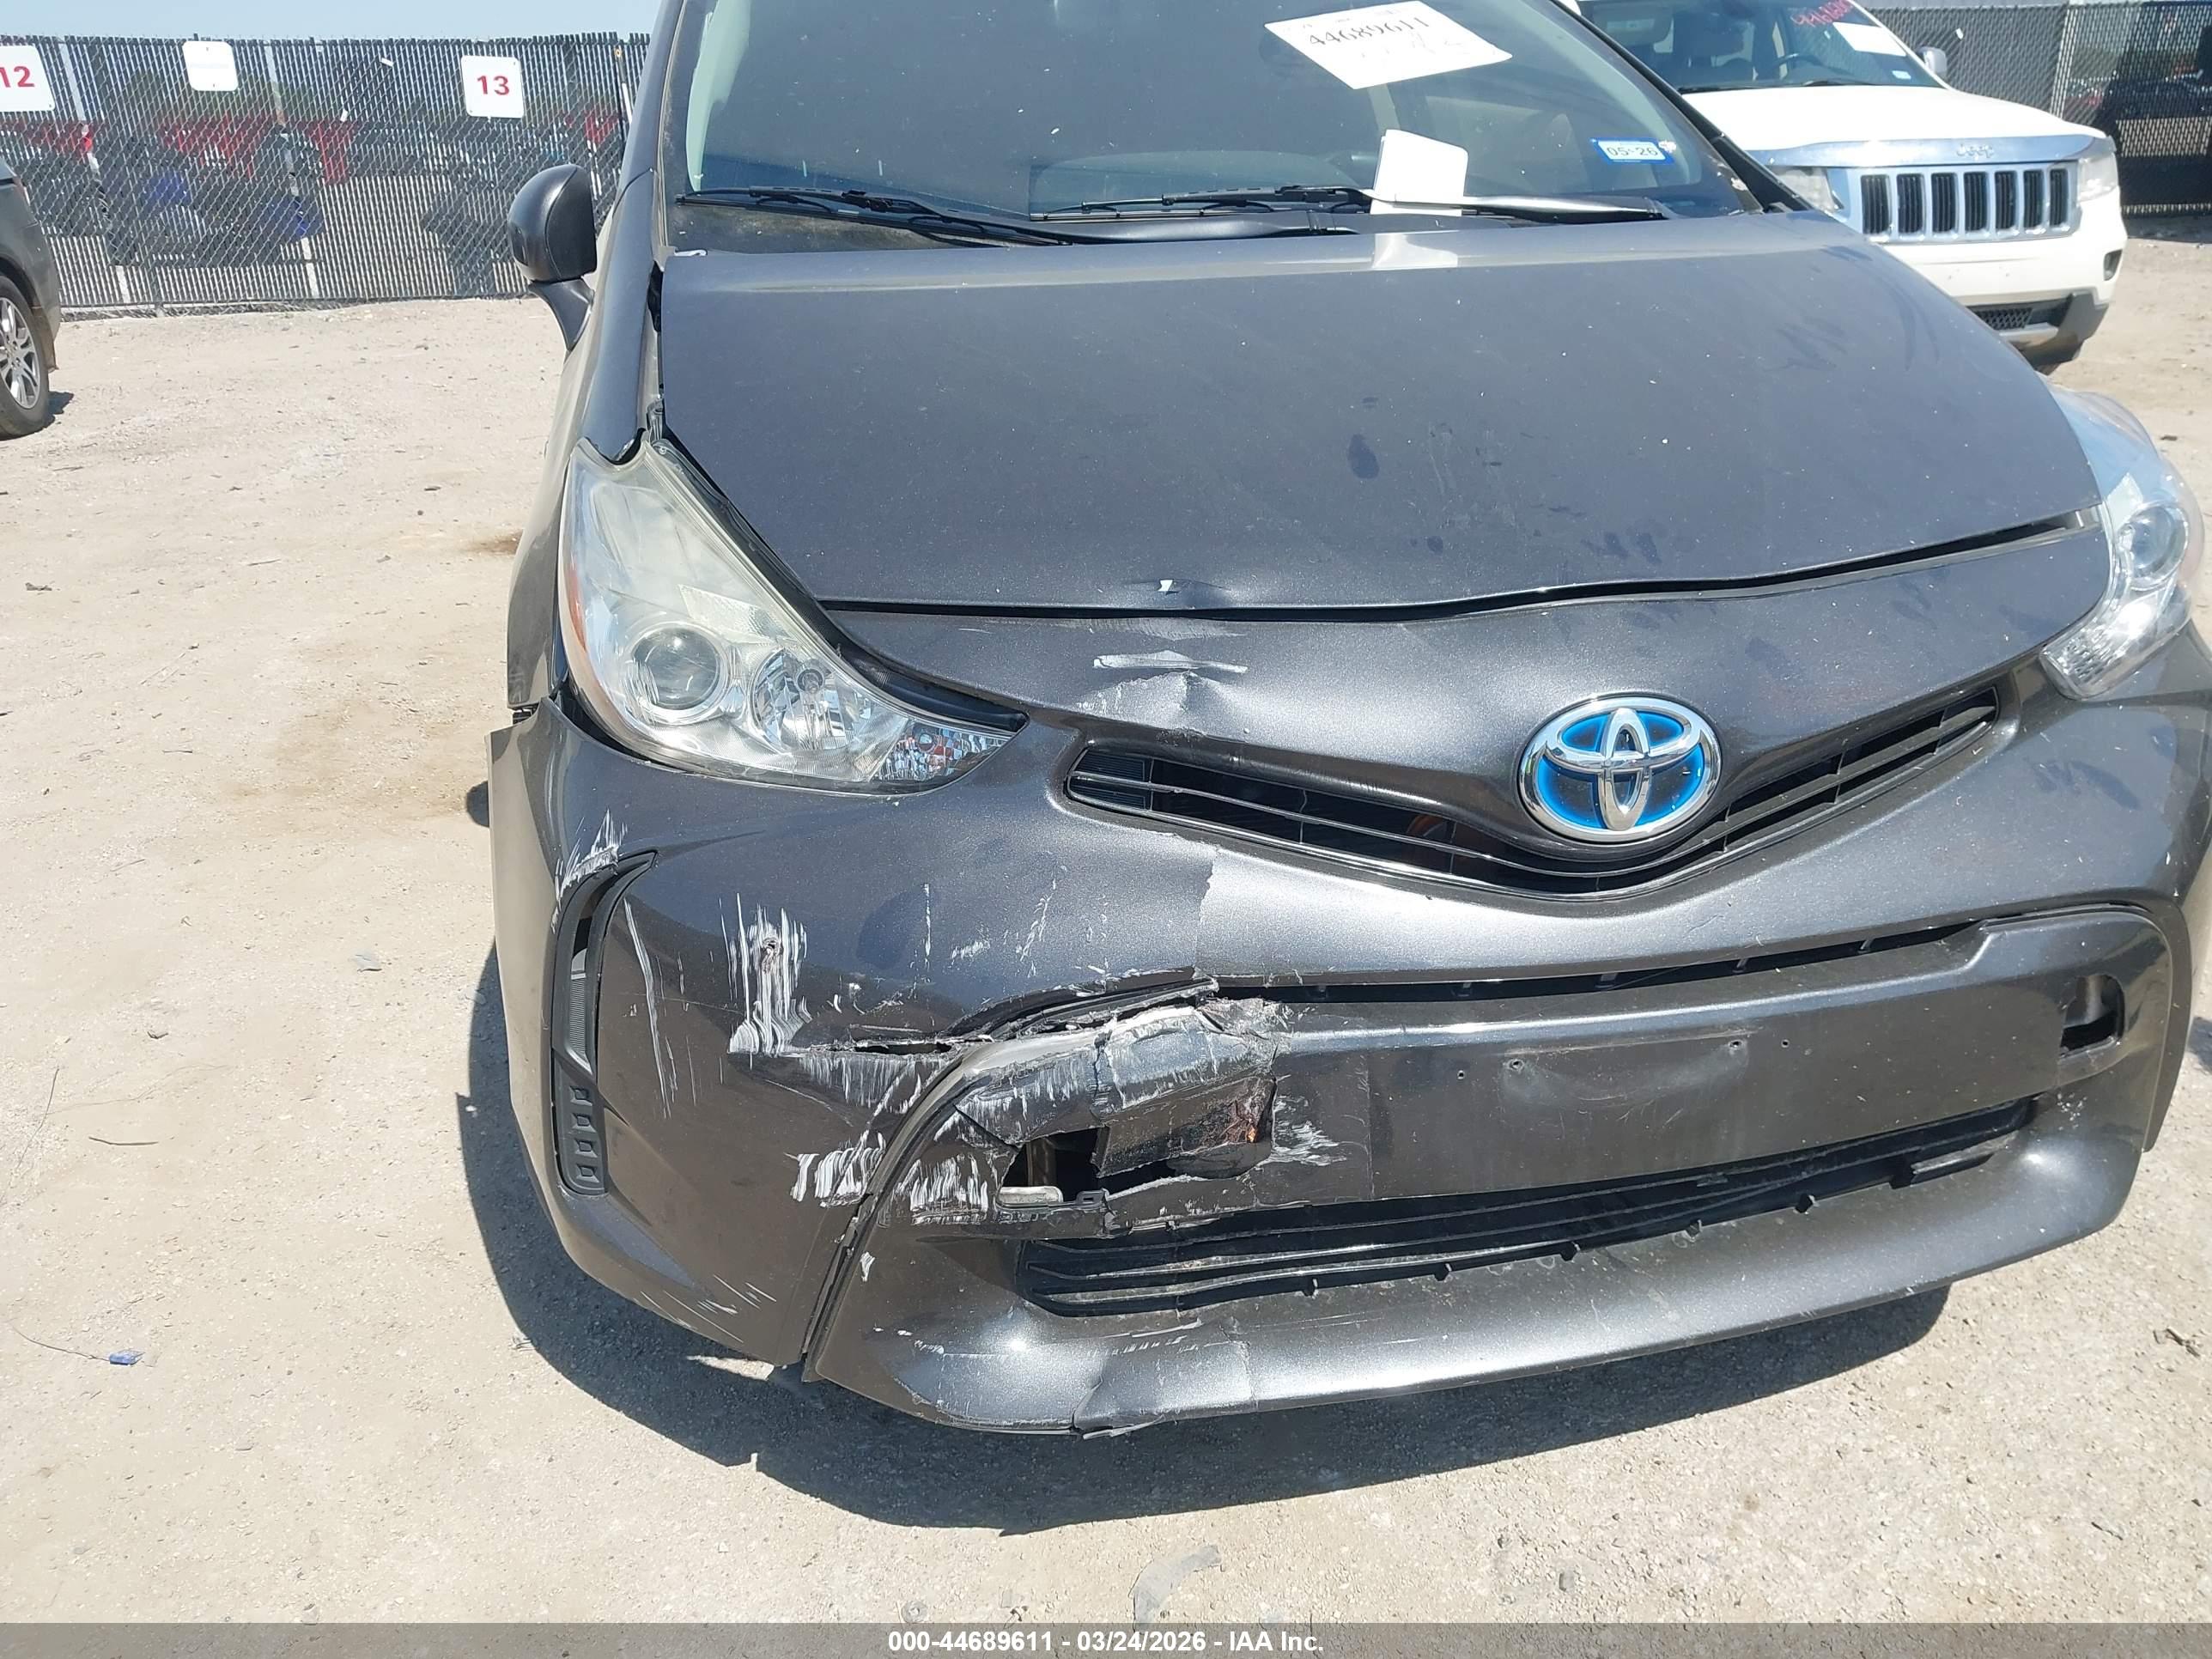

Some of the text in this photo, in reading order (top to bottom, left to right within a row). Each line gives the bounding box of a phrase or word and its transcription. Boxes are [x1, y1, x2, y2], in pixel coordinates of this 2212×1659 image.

[0, 65, 35, 88] 12
[477, 75, 509, 95] 13
[1956, 143, 1994, 159] Jeep
